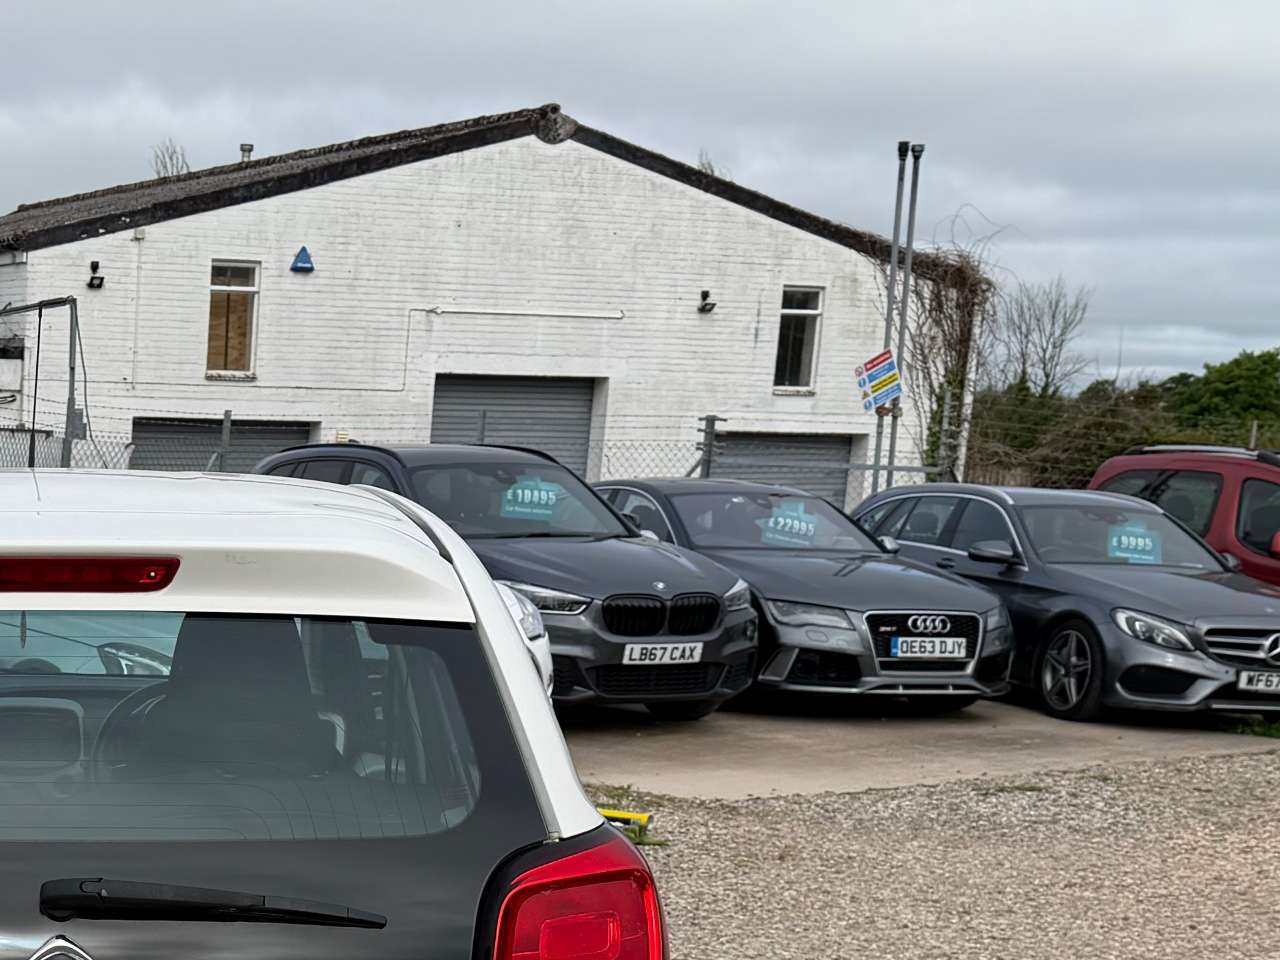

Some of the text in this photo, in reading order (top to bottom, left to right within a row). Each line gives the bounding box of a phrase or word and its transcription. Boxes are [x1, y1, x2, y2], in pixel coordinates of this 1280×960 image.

[628, 645, 698, 662] LB67 CAX
[900, 640, 964, 655] OE63 DJY
